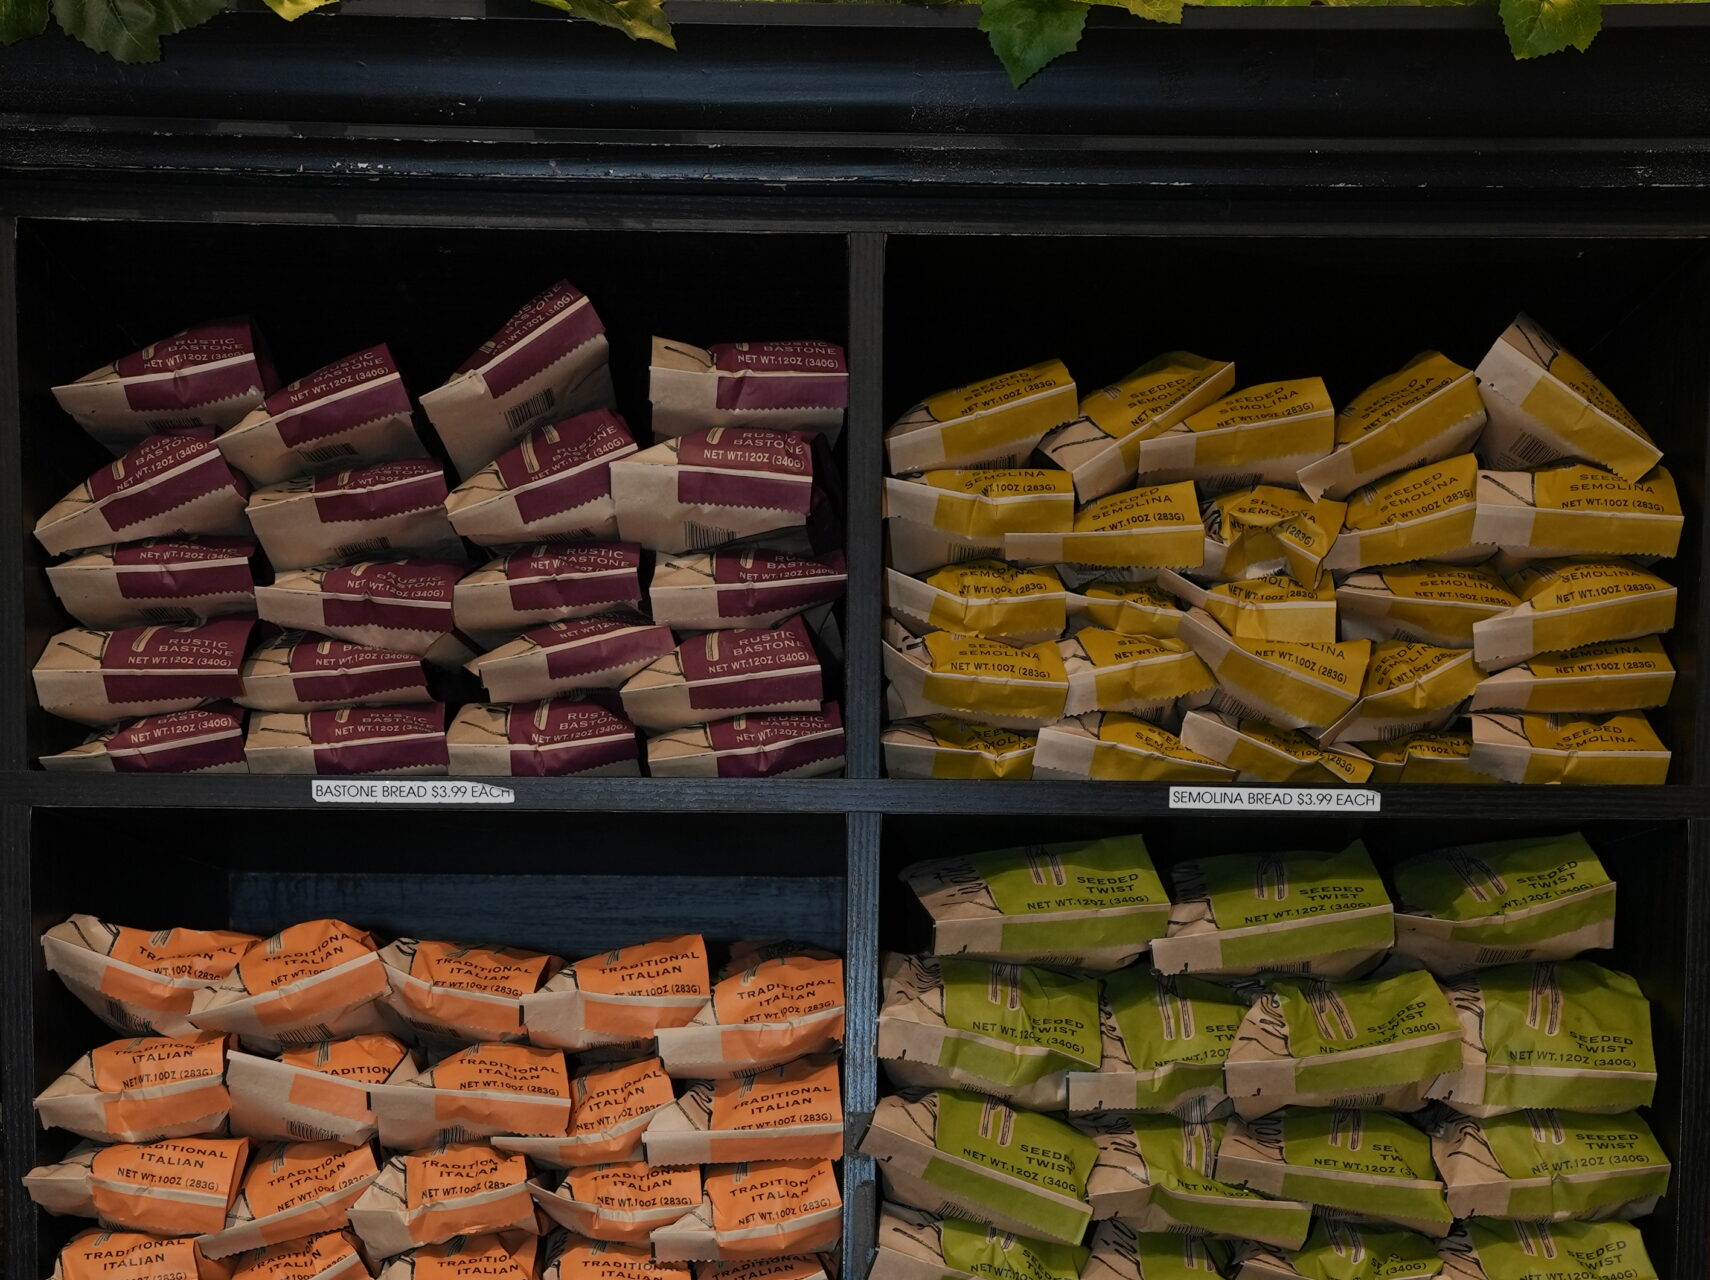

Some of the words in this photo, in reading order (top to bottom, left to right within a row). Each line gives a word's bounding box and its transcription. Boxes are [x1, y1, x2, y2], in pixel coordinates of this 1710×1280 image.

[764, 345, 837, 355] BASTONE
[738, 355, 757, 364] NET
[805, 358, 839, 369] (340G)
[290, 390, 310, 403] NET
[355, 366, 390, 381] (340G)
[963, 374, 1043, 401] SEMOLINA
[960, 407, 979, 415] NET
[1024, 379, 1056, 394] (283G)
[1219, 390, 1299, 415] SEMOLINA
[1217, 420, 1237, 428] NET
[1282, 402, 1314, 418] (283G)
[734, 440, 804, 455] BASTONE
[117, 478, 134, 491] NET
[177, 441, 208, 461] (340G)
[704, 449, 724, 459] NET
[772, 455, 805, 470] (340G)
[1023, 483, 1056, 492] (283G)
[1570, 483, 1655, 494] SEMOLINA
[1442, 488, 1474, 505] (283G)
[1561, 500, 1582, 509] NET
[1632, 499, 1665, 512] (283G)
[1153, 512, 1185, 523] (283G)
[566, 548, 624, 559] RUSTIC
[1556, 594, 1577, 604] NET
[1624, 583, 1656, 593] (283G)
[169, 638, 229, 649] RUSTIC
[739, 631, 796, 646] RUSTIC
[158, 645, 234, 657] BASTONE
[960, 650, 1040, 660] SEMOLINA
[128, 656, 149, 664] NET
[197, 658, 232, 667] (340G)
[708, 663, 728, 674] NET
[776, 651, 809, 665] (340G)
[1256, 649, 1275, 658] NET
[1318, 665, 1348, 684] (283G)
[1555, 666, 1575, 674] NET
[1623, 661, 1656, 670] (283G)
[951, 662, 970, 671] NET
[1018, 667, 1050, 679] (283G)
[131, 732, 150, 744] NET
[198, 717, 232, 730] (340G)
[316, 785, 378, 798] BASTONE
[382, 786, 427, 798] BREAD
[432, 784, 467, 798] $3.99
[472, 786, 510, 798] EACH
[1173, 790, 1244, 804] SEMOLINA
[1248, 792, 1292, 805] BREAD
[1297, 792, 1332, 806] $3.99
[1336, 794, 1375, 806] EACH
[1077, 873, 1139, 885] SEEDED
[1516, 860, 1578, 885] SEEDED
[1528, 872, 1577, 890] TWIST
[1085, 884, 1135, 894] TWIST
[1299, 886, 1365, 895] SEEDED
[1027, 901, 1050, 910] NET
[1109, 895, 1149, 905] (340G)
[1307, 893, 1359, 901] TWIST
[1244, 914, 1269, 924] NET
[1329, 901, 1372, 911] (340G)
[435, 958, 533, 974] TRADITIONAL
[600, 951, 700, 975] TRADITIONAL
[450, 968, 510, 981] ITALIAN
[621, 965, 682, 981] ITALIAN
[672, 984, 701, 995] (283G)
[737, 978, 835, 1000] TRADITIONAL
[759, 990, 816, 1007] ITALIAN
[804, 1000, 835, 1013] (283G)
[1401, 1022, 1441, 1036] (340G)
[972, 1021, 996, 1032] NET
[1046, 1036, 1085, 1055] (340G)
[1569, 1031, 1633, 1045] SEEDED
[1577, 1042, 1627, 1053] TWIST
[459, 1058, 559, 1074] TRADITIONAL
[1509, 1050, 1534, 1061] NET
[1594, 1058, 1637, 1068] (340G)
[479, 1068, 540, 1080] ITALIAN
[527, 1085, 560, 1096] (283G)
[1576, 1133, 1639, 1141] SEEDED
[1586, 1142, 1635, 1150] TWIST
[141, 1152, 205, 1168] ITALIAN
[963, 1148, 988, 1163] NET
[1609, 1154, 1649, 1166] (340G)
[1026, 1156, 1073, 1176] TWIST
[117, 1167, 138, 1179] NET
[185, 1178, 219, 1191] (283G)
[613, 1179, 672, 1192] ITALIAN
[729, 1169, 826, 1197] TRADITIONAL
[660, 1197, 692, 1206] (283G)
[752, 1187, 810, 1202] ITALIAN
[739, 1214, 756, 1226] NET
[799, 1197, 831, 1214] (283G)
[84, 1238, 185, 1261] TRADITIONAL
[103, 1253, 165, 1271] ITALIAN
[457, 1264, 519, 1275] ITALIAN
